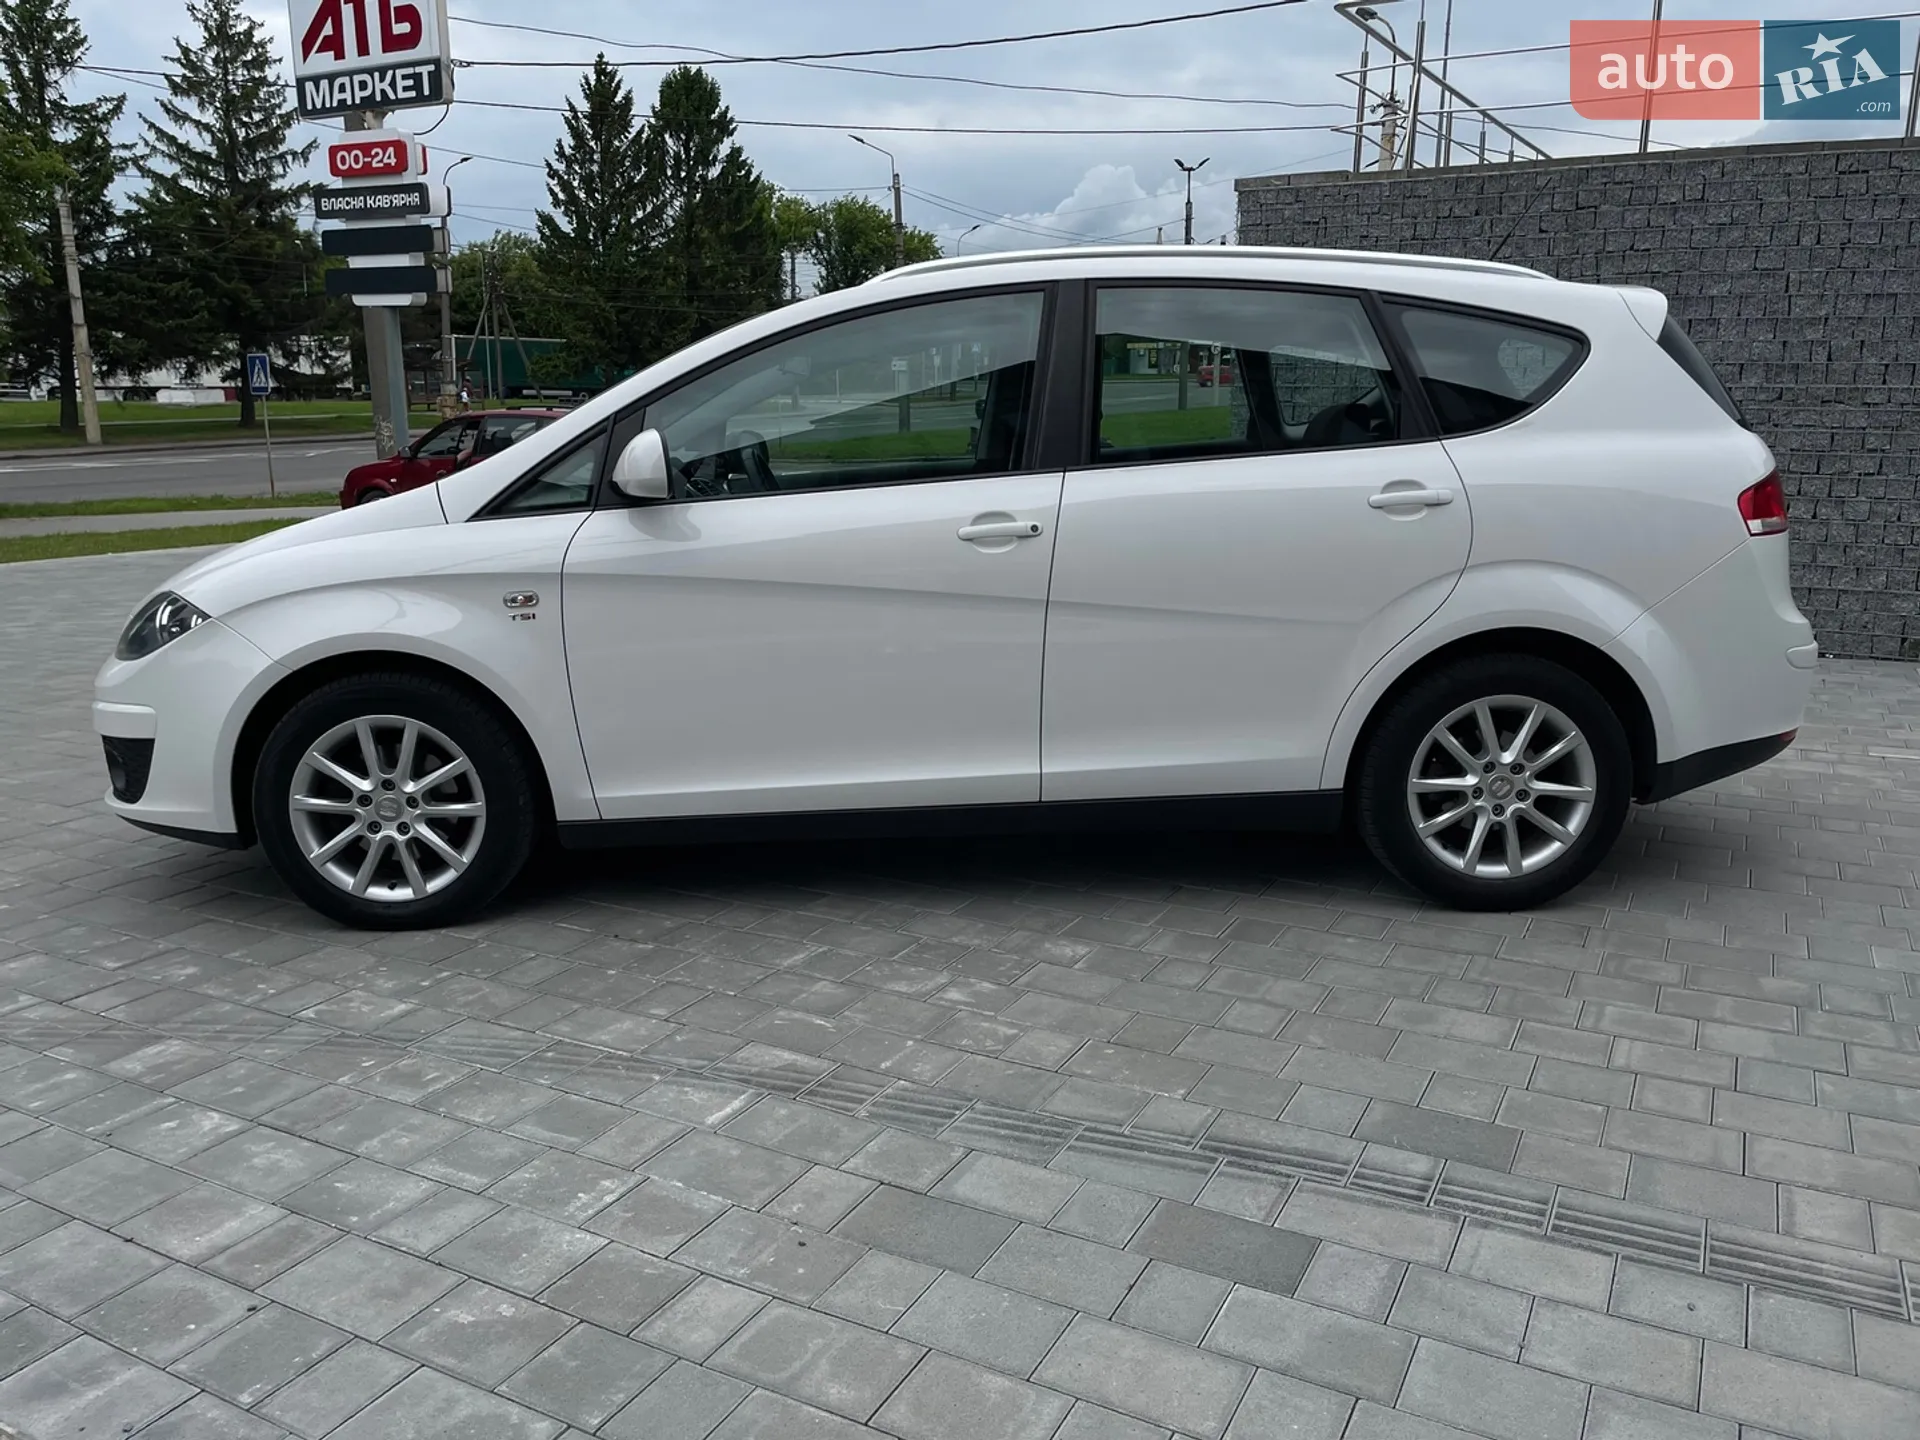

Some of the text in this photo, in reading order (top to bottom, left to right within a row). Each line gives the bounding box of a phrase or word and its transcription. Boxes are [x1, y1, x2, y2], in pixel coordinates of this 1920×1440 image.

[305, 64, 435, 110] МАРКЕТ
[336, 146, 397, 170] 00-24
[321, 196, 364, 211] ВЛАСНА
